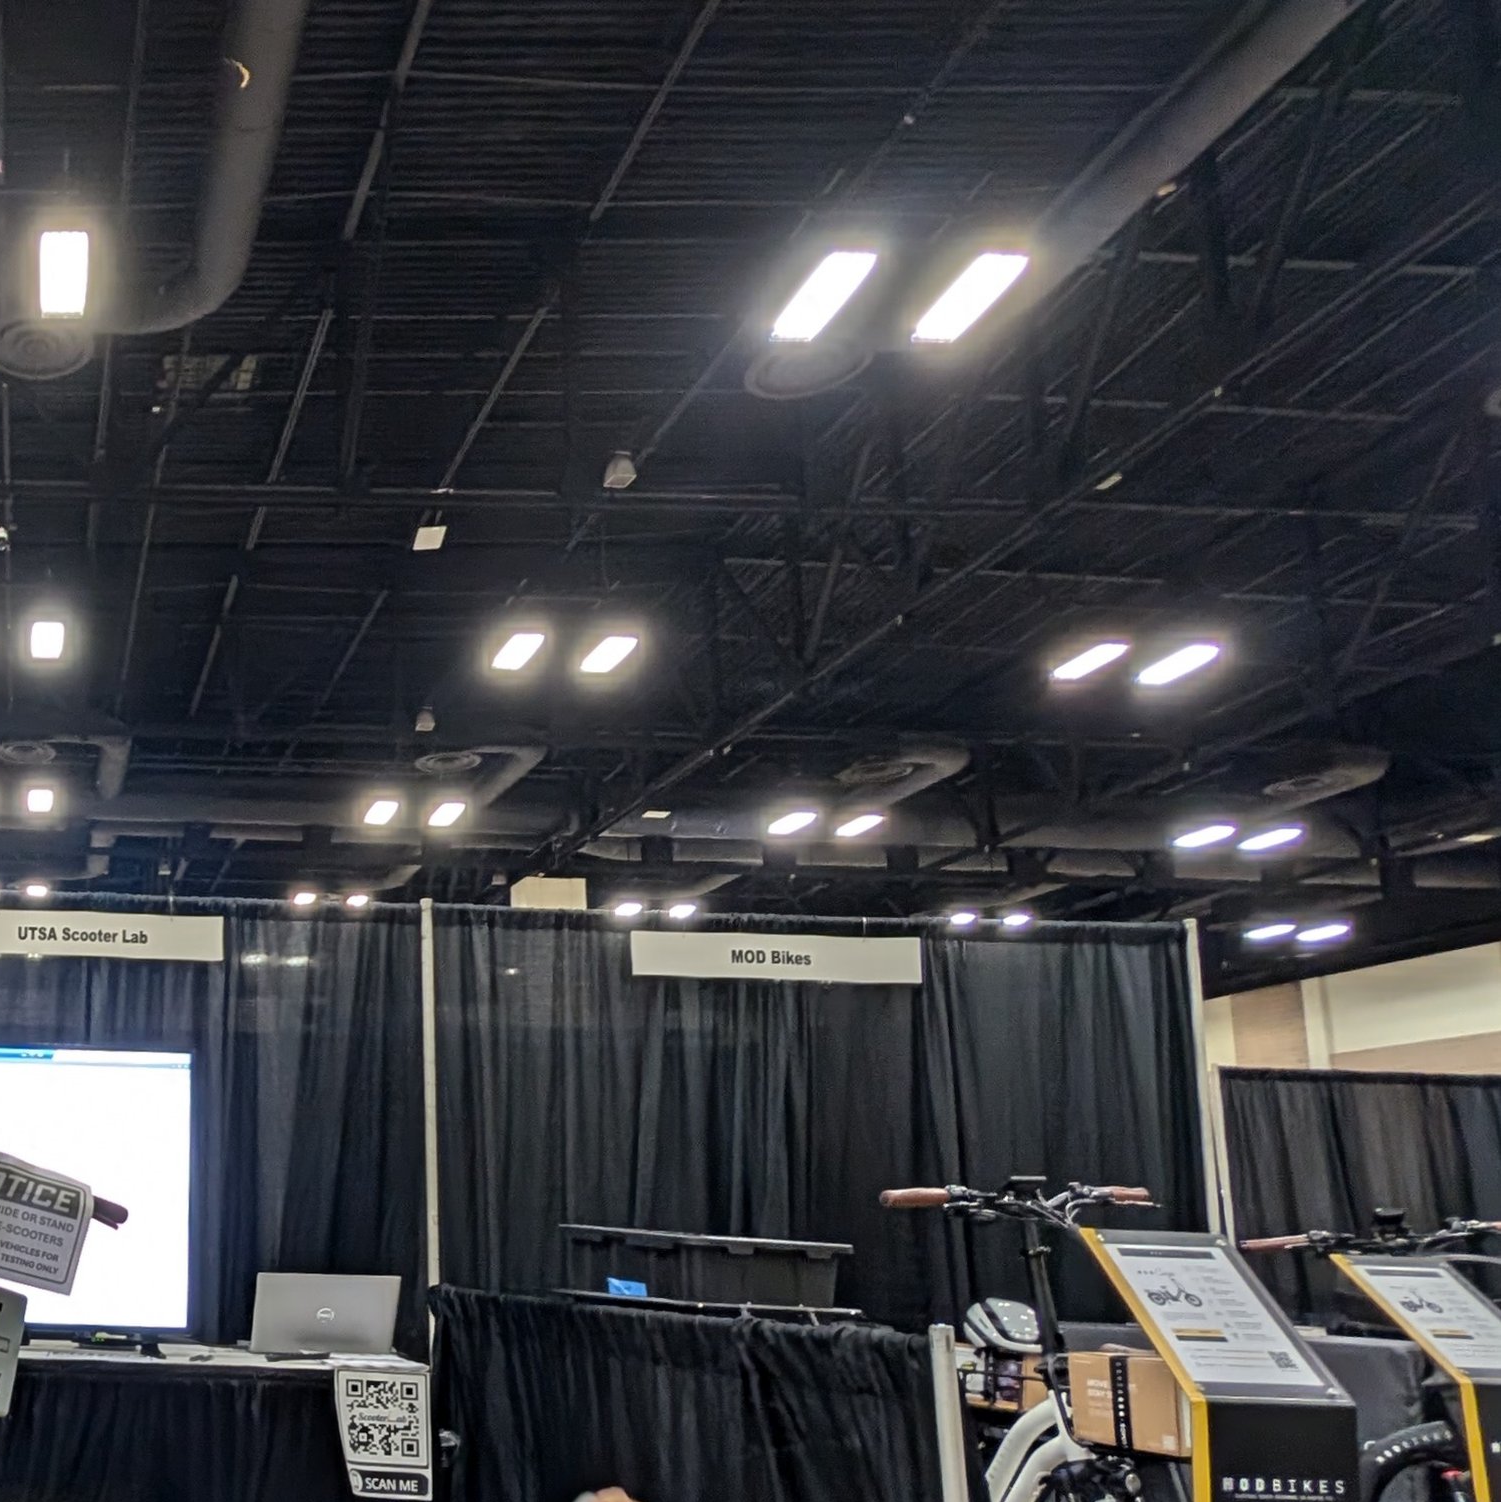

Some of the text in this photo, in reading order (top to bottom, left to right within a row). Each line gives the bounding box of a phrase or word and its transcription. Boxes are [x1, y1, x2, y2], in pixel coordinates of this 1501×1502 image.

[18, 926, 148, 944] UTSA Scooter Lab
[731, 949, 812, 966] MOD Bikes
[21, 1211, 37, 1224] OR
[39, 1215, 74, 1233] STAND
[0, 1239, 40, 1258] VEHICLES
[41, 1251, 59, 1262] FOR
[1, 1253, 35, 1269] TESTING
[35, 1263, 59, 1275] ONLY
[365, 1477, 419, 1493] SCAN ME
[1221, 1477, 1345, 1495] MODBIKES
